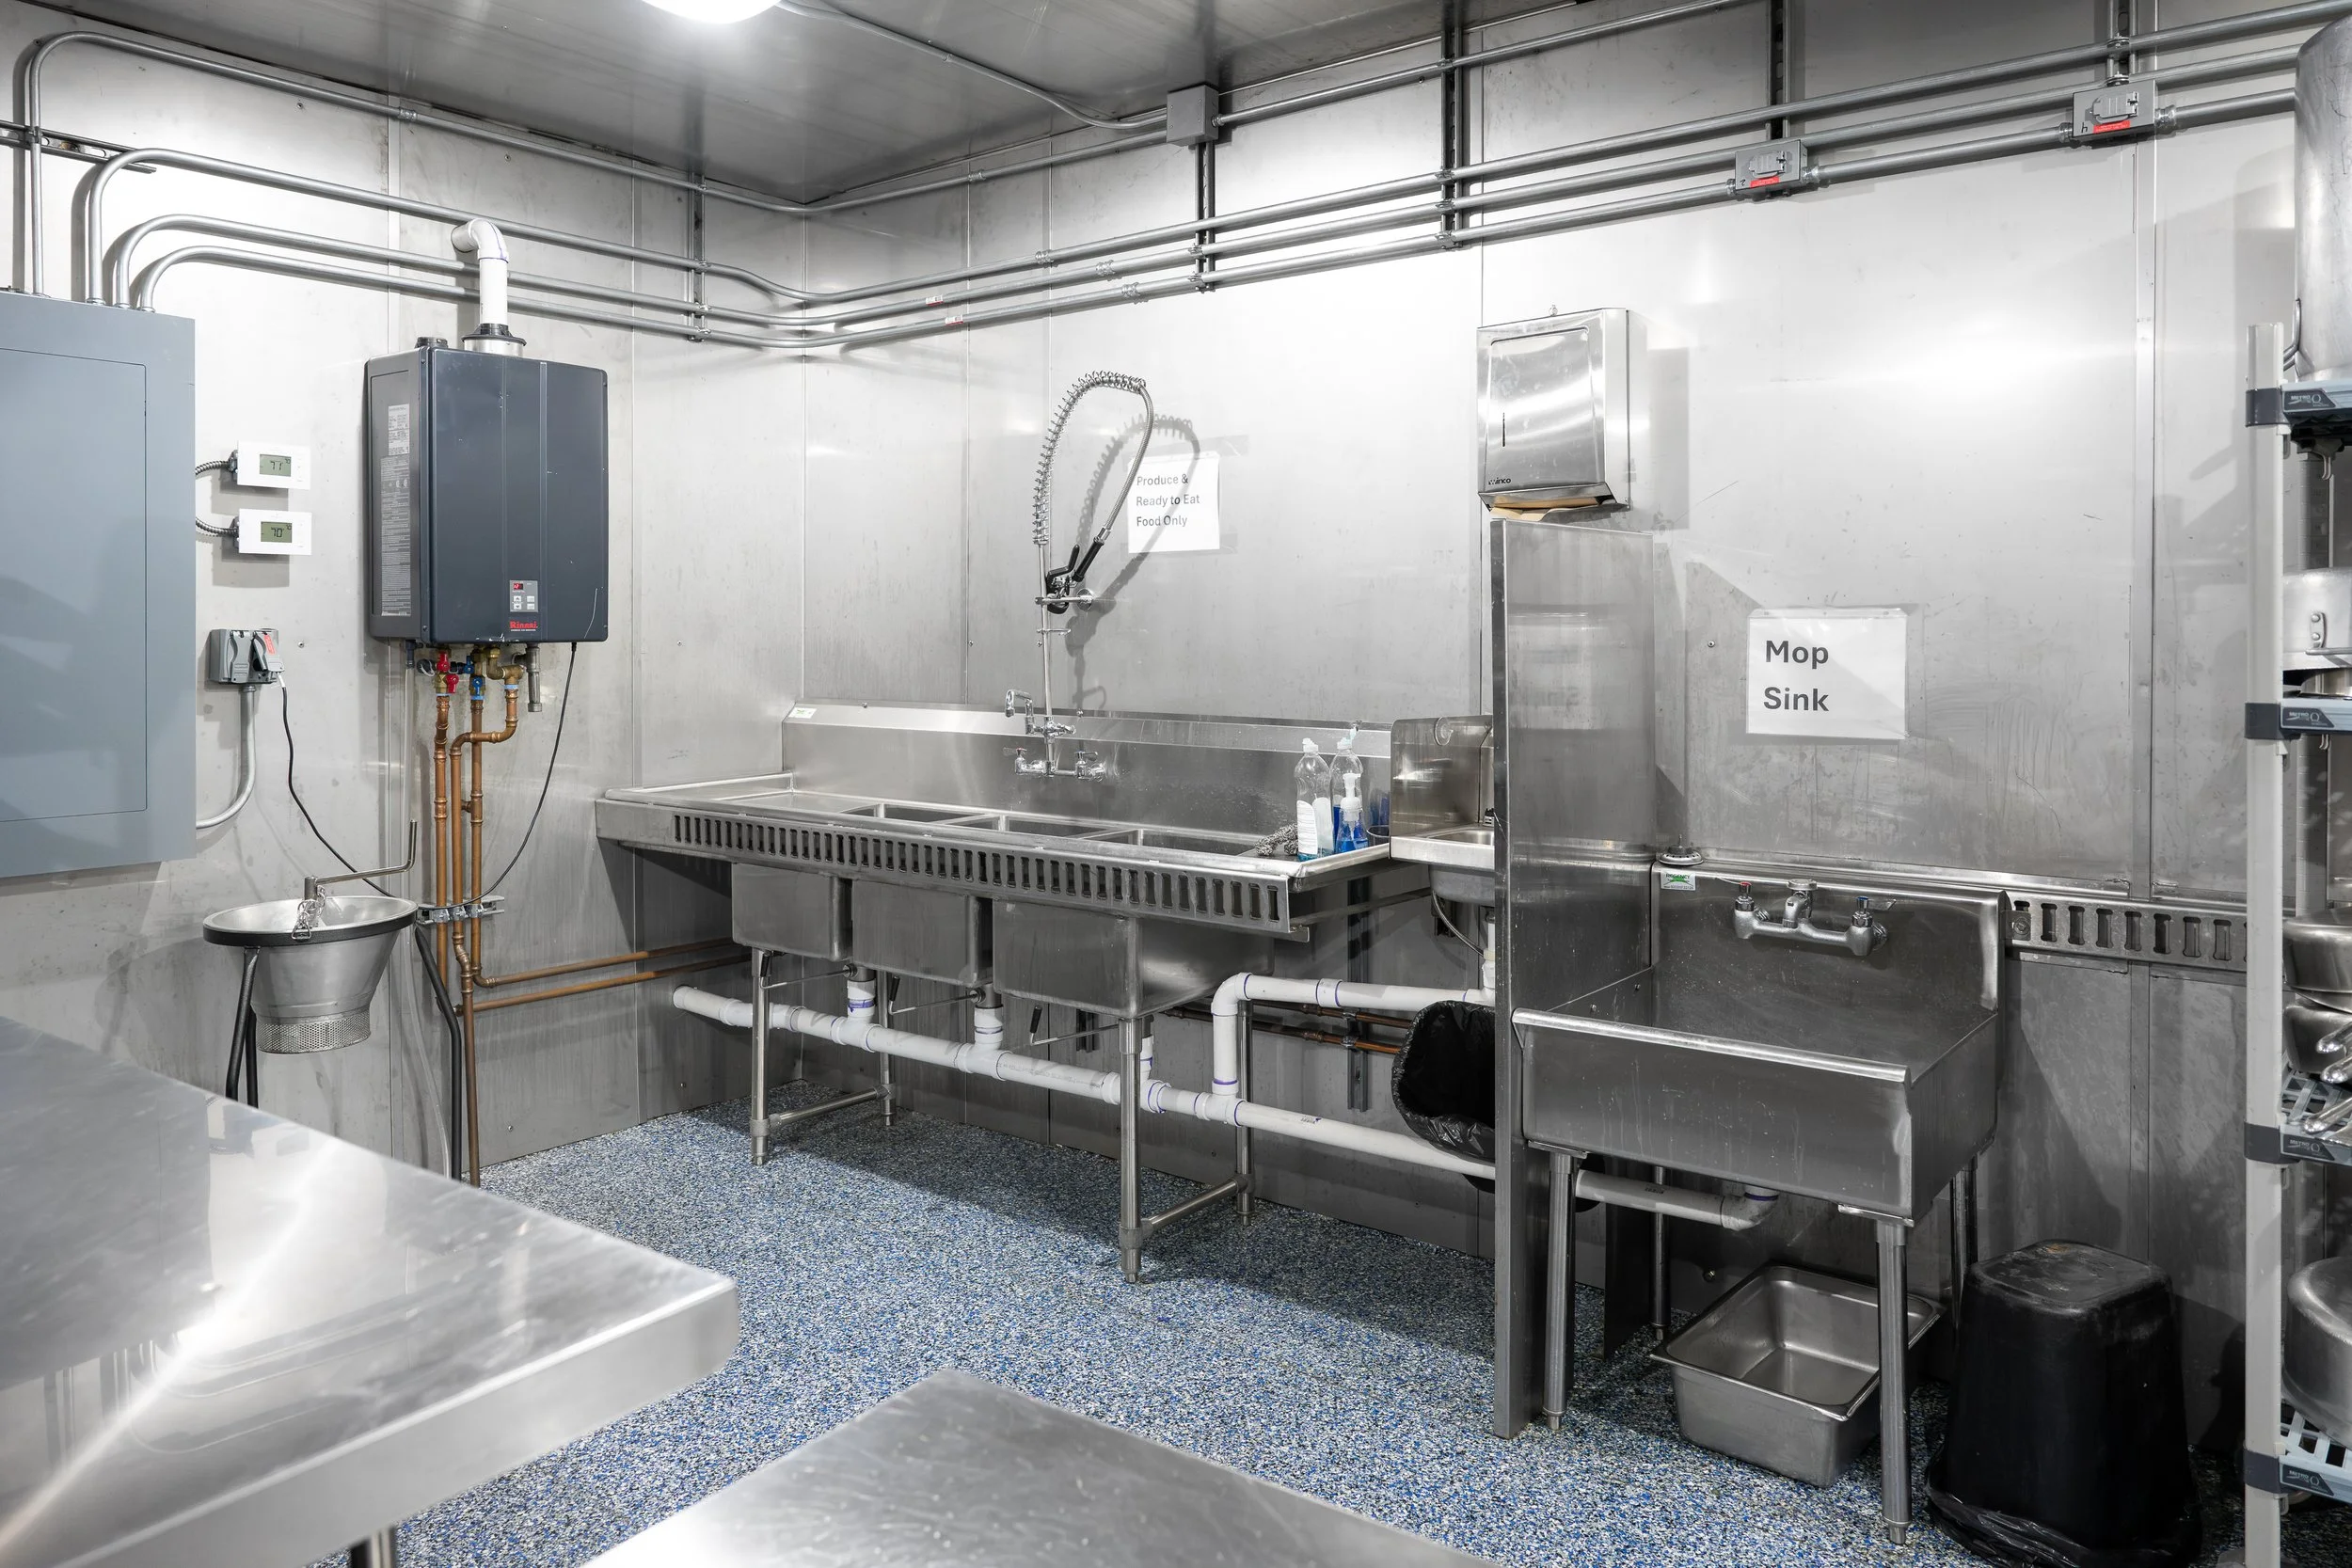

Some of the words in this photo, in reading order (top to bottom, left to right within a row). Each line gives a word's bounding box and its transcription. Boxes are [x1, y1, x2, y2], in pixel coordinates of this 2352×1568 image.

[1136, 475, 1179, 486] Produce
[1181, 473, 1189, 484] &
[1136, 495, 1168, 508] Ready
[1170, 496, 1181, 505] to
[1183, 494, 1200, 504] Eat
[1136, 516, 1161, 527] Food
[1163, 515, 1188, 527] Only
[1765, 640, 1829, 670] Mop
[1763, 687, 1830, 712] Sink
